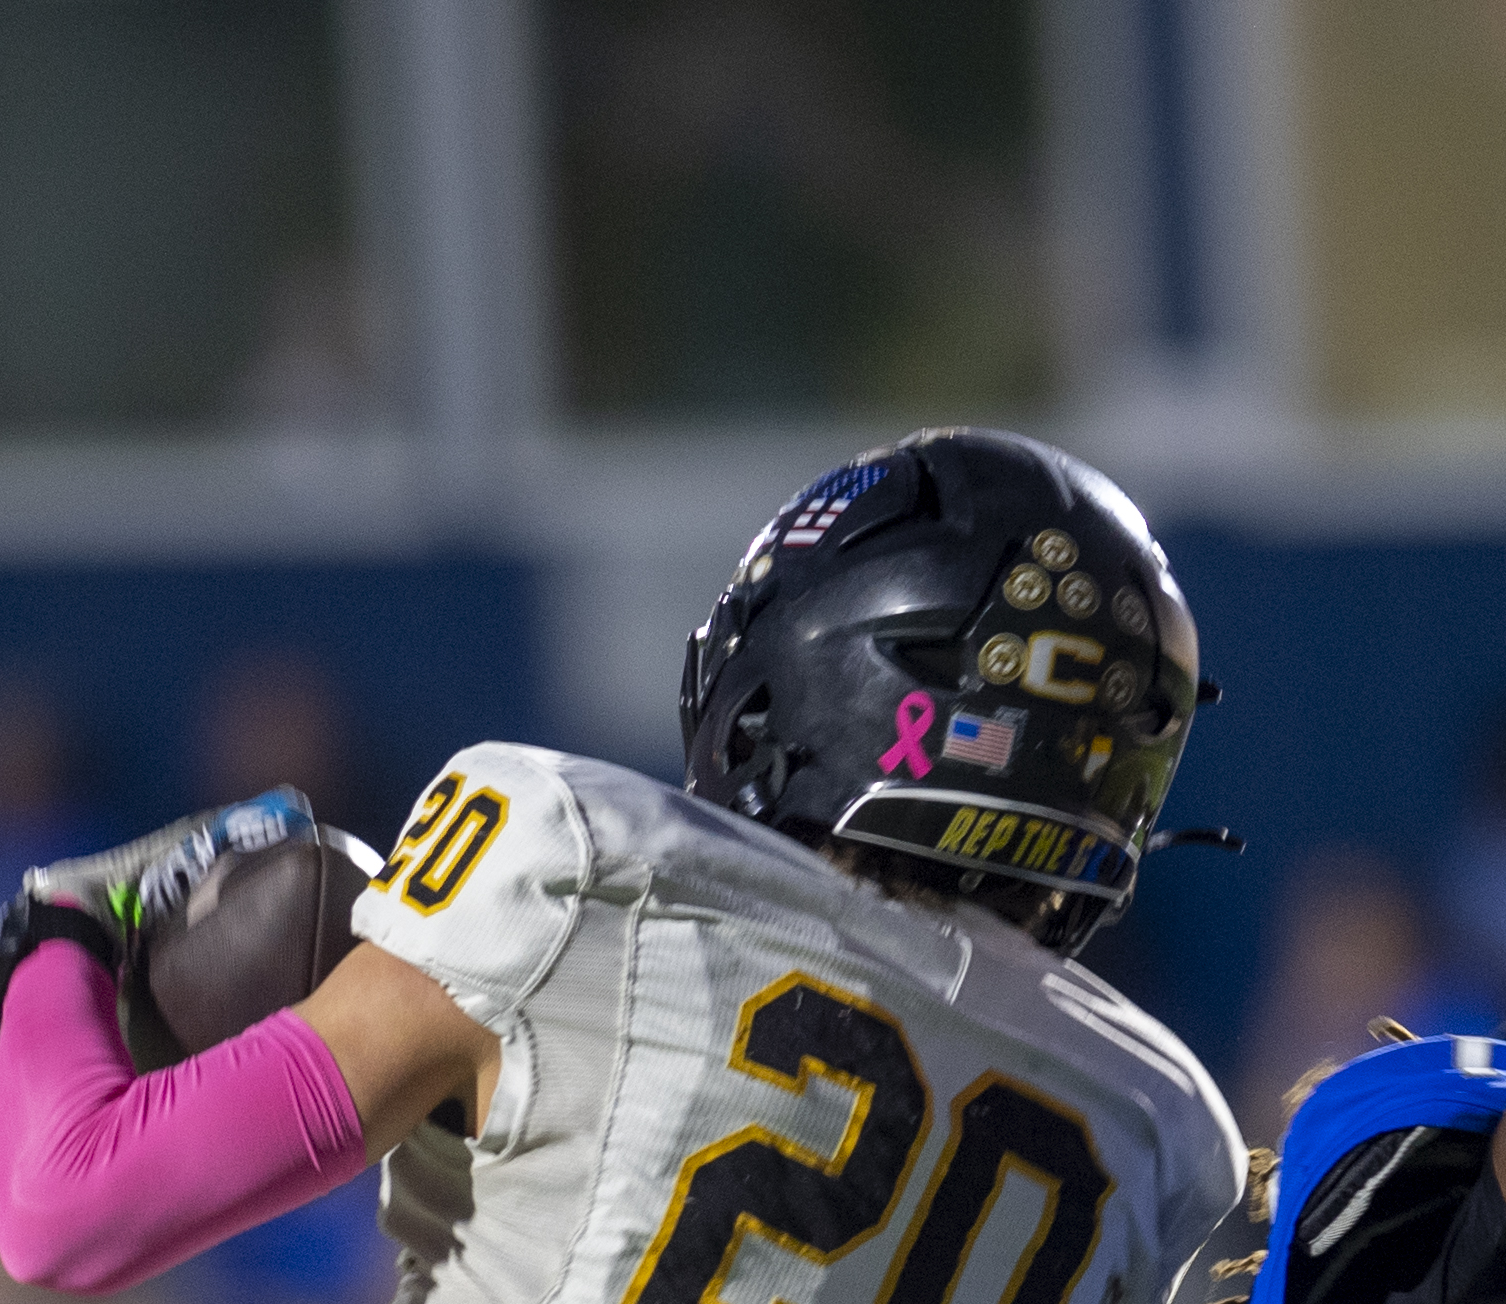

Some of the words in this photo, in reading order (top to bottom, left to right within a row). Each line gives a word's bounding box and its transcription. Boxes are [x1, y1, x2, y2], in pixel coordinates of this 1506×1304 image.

[1019, 629, 1106, 704] C
[367, 770, 511, 918] 20
[935, 805, 1020, 860] REP
[1010, 819, 1074, 873] THE
